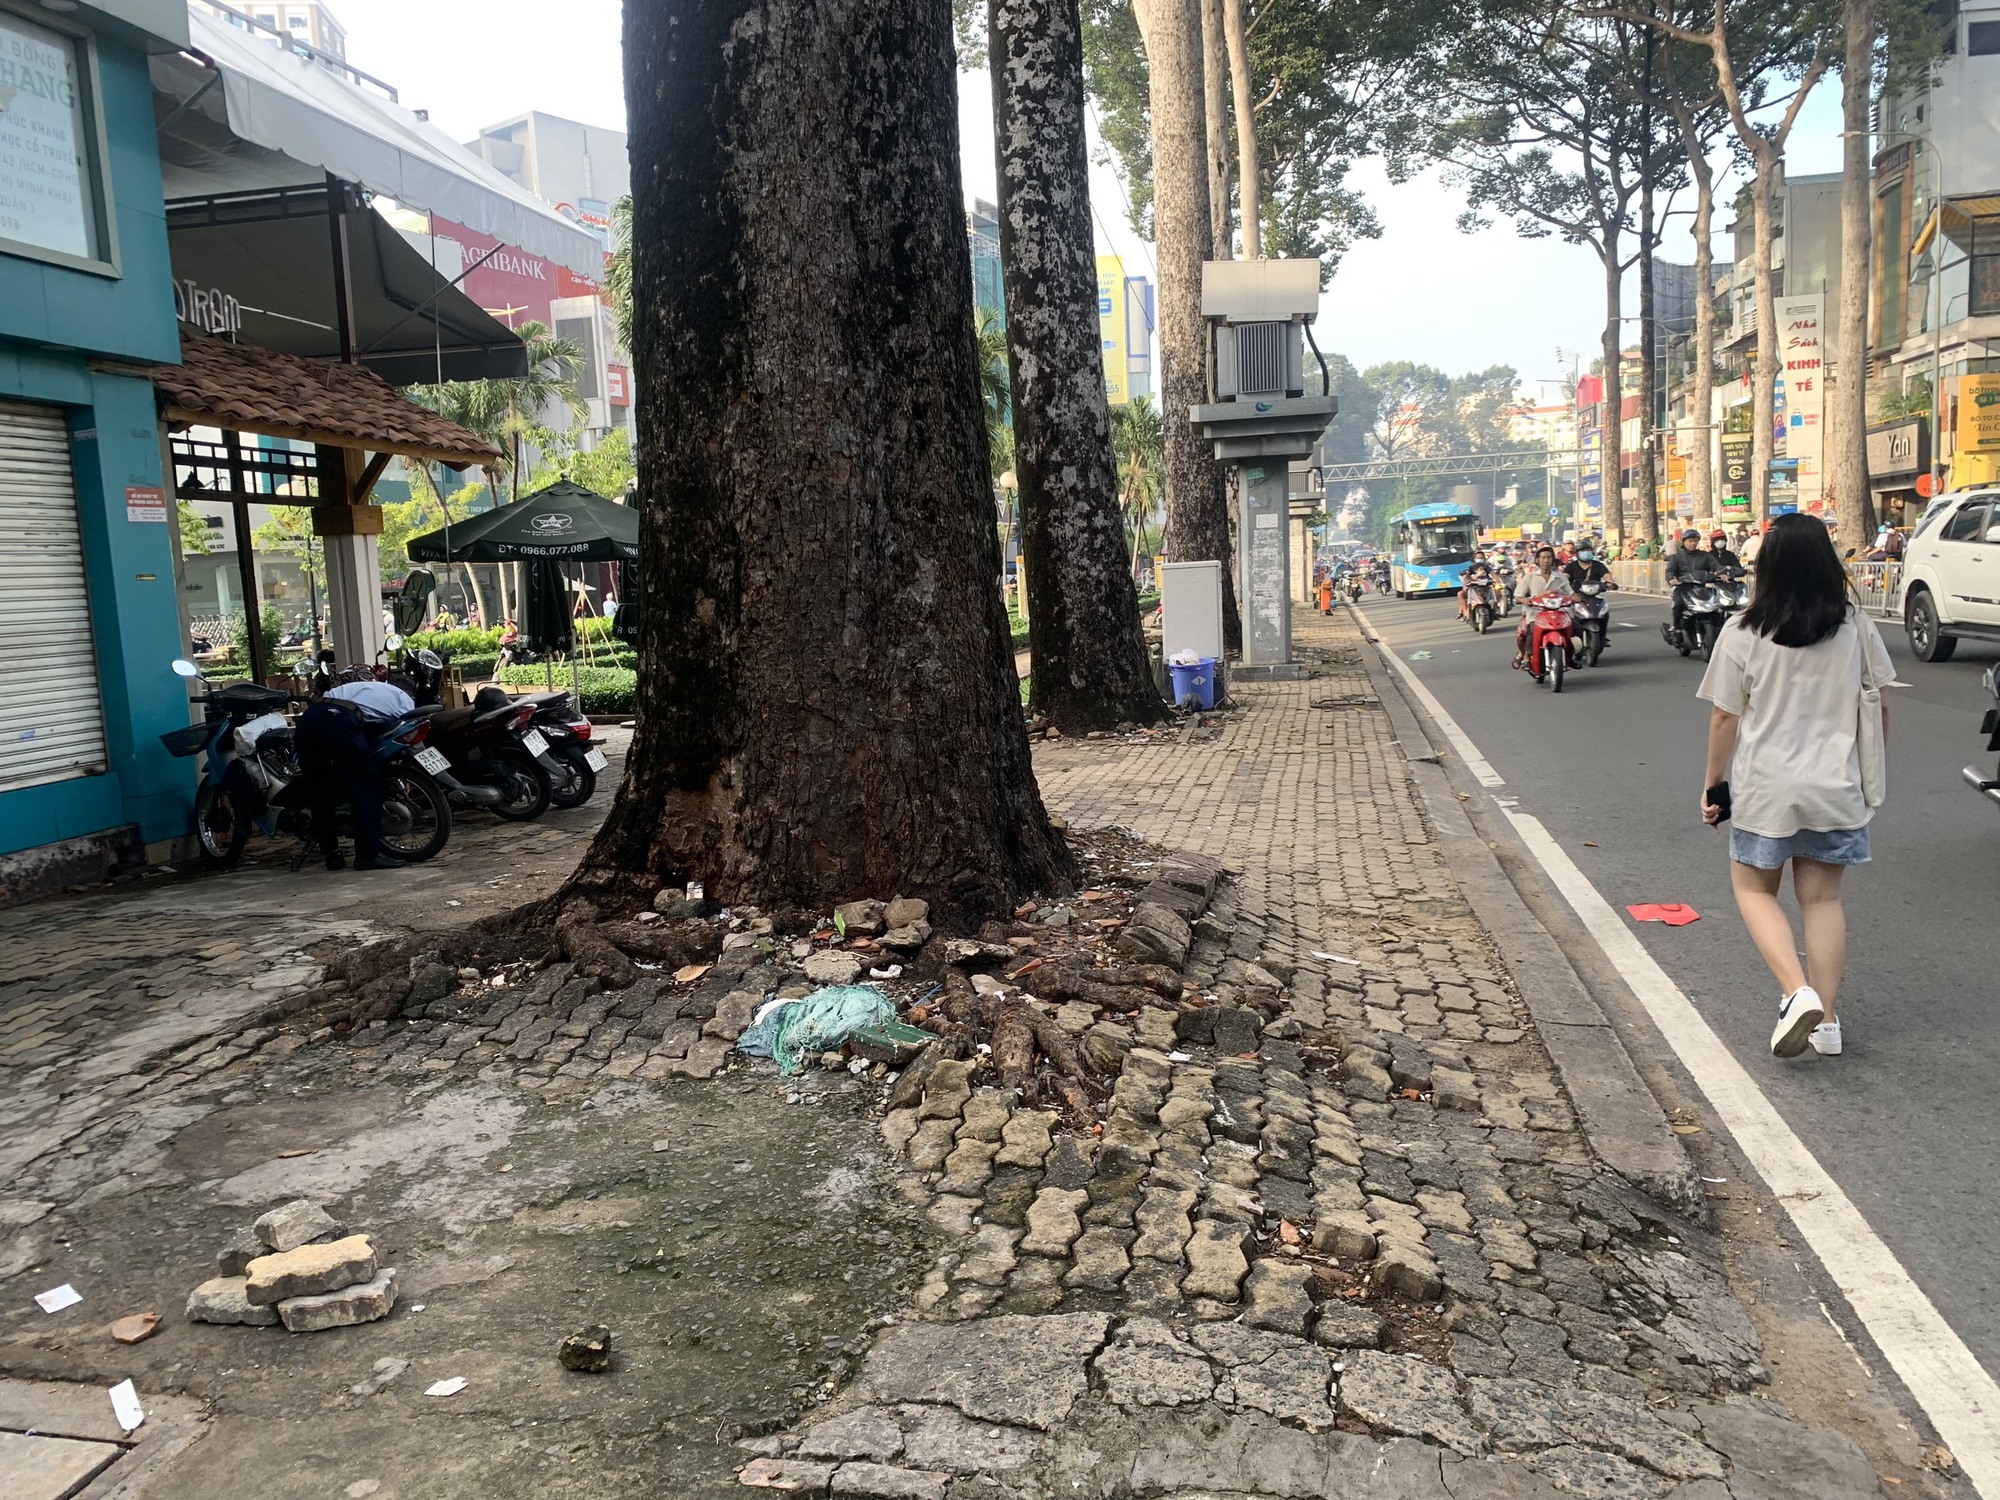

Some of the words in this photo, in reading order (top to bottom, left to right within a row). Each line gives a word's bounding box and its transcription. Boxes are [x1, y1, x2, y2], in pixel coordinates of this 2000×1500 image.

[1788, 319, 1818, 331] Nhà
[1787, 337, 1819, 350] Sách
[1787, 359, 1822, 370] KINH
[1796, 377, 1813, 391] TẾ
[520, 543, 589, 555] 0966.077.088
